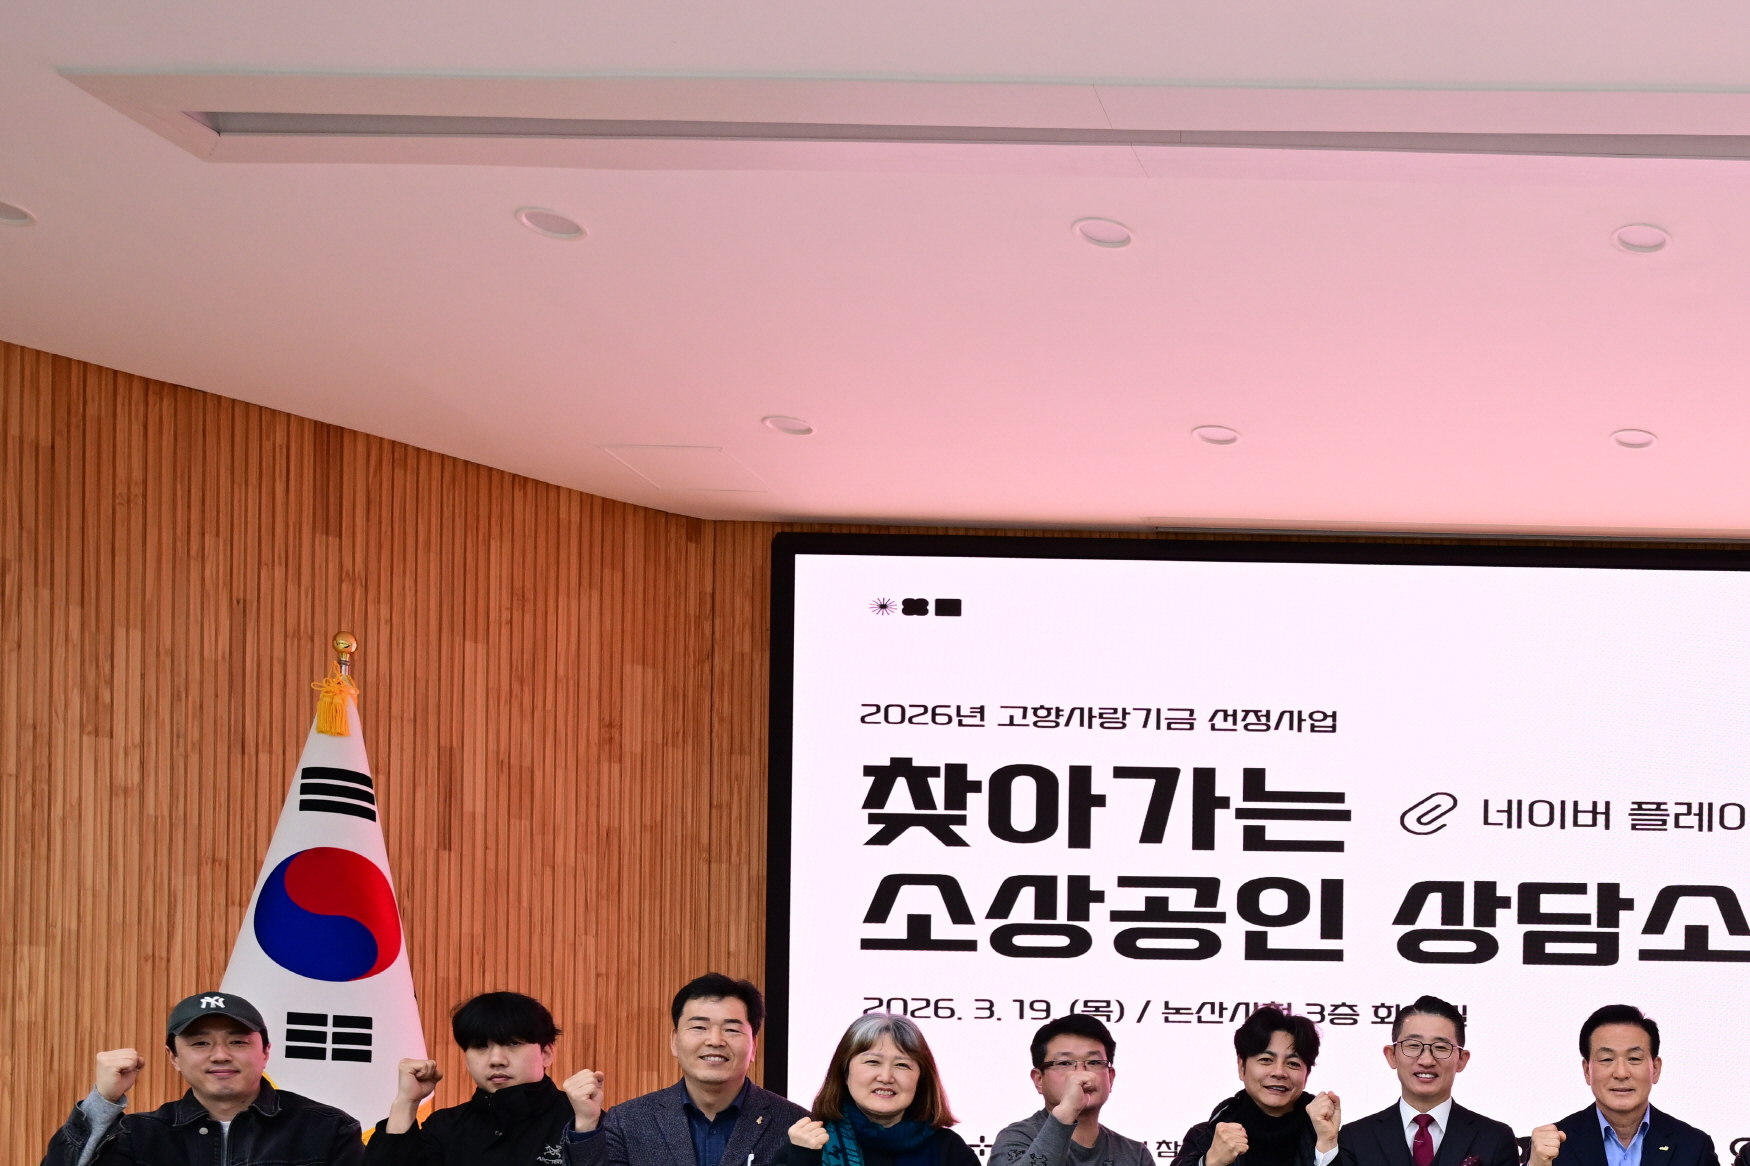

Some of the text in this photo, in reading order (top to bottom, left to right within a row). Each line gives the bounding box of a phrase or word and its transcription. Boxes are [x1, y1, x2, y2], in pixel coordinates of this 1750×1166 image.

[860, 703, 1338, 734] 2026년 고향사랑기금 선정사업
[861, 756, 1352, 853] 찾아가는
[1483, 798, 1611, 831] 네이버
[859, 873, 1344, 962] 소상공인
[200, 996, 226, 1009] NY
[862, 997, 963, 1021] 2026.
[973, 998, 1002, 1021] 3.
[1069, 999, 1125, 1024] (목)
[1135, 999, 1152, 1024] /
[1306, 1001, 1360, 1026] 3층
